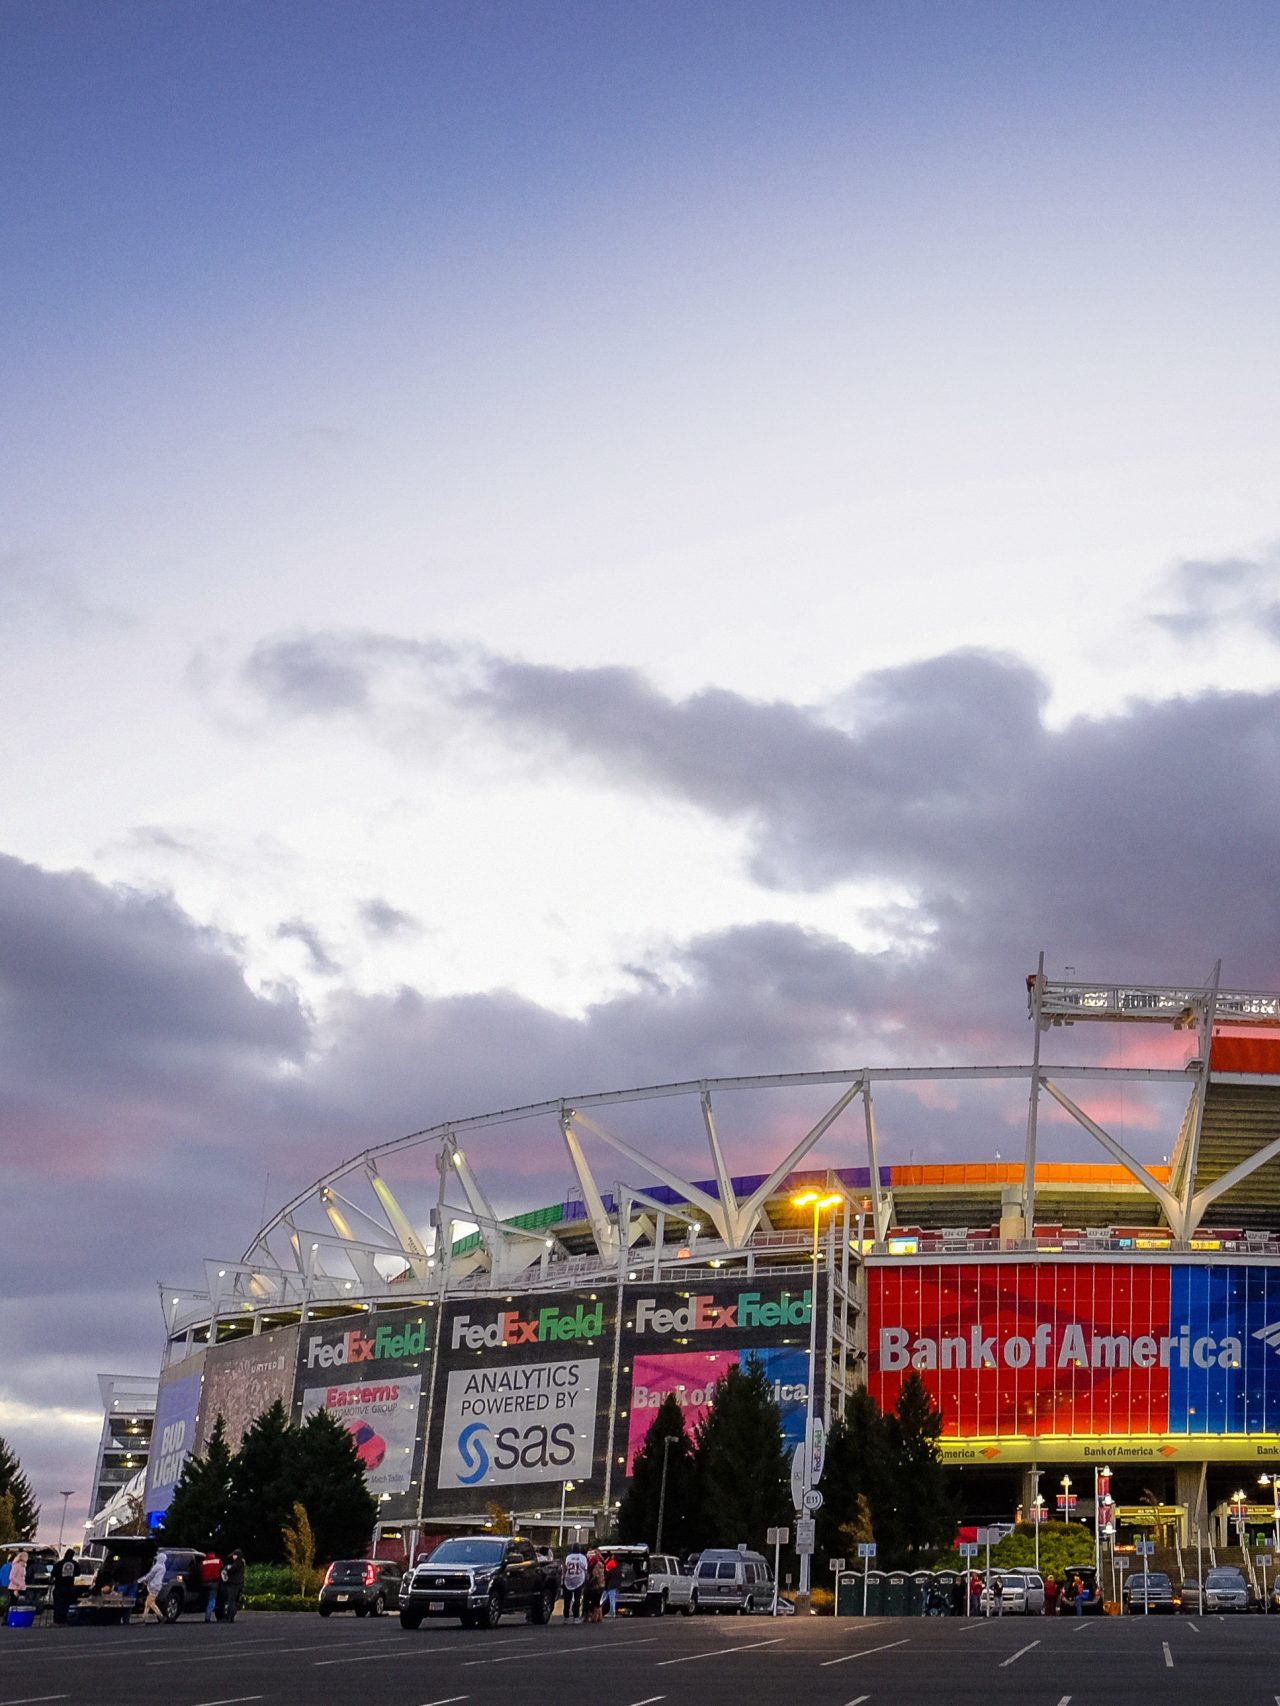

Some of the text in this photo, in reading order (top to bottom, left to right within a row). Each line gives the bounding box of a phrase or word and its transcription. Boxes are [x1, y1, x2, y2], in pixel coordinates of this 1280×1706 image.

[636, 1289, 813, 1333] FedExField
[452, 1303, 603, 1349] FedExField
[307, 1321, 426, 1368] FedExField
[880, 1323, 1241, 1371] Bank of America
[464, 1365, 579, 1394] ANALYTICS
[691, 1382, 714, 1406] of
[326, 1385, 399, 1408] Easterns
[328, 1404, 397, 1418] UTOMOTIVE GROUP
[461, 1391, 578, 1416] POWERED BY
[161, 1420, 185, 1457] BUD
[494, 1423, 575, 1469] sas
[1084, 1446, 1153, 1456] Bank of America
[1257, 1446, 1279, 1455] Bank
